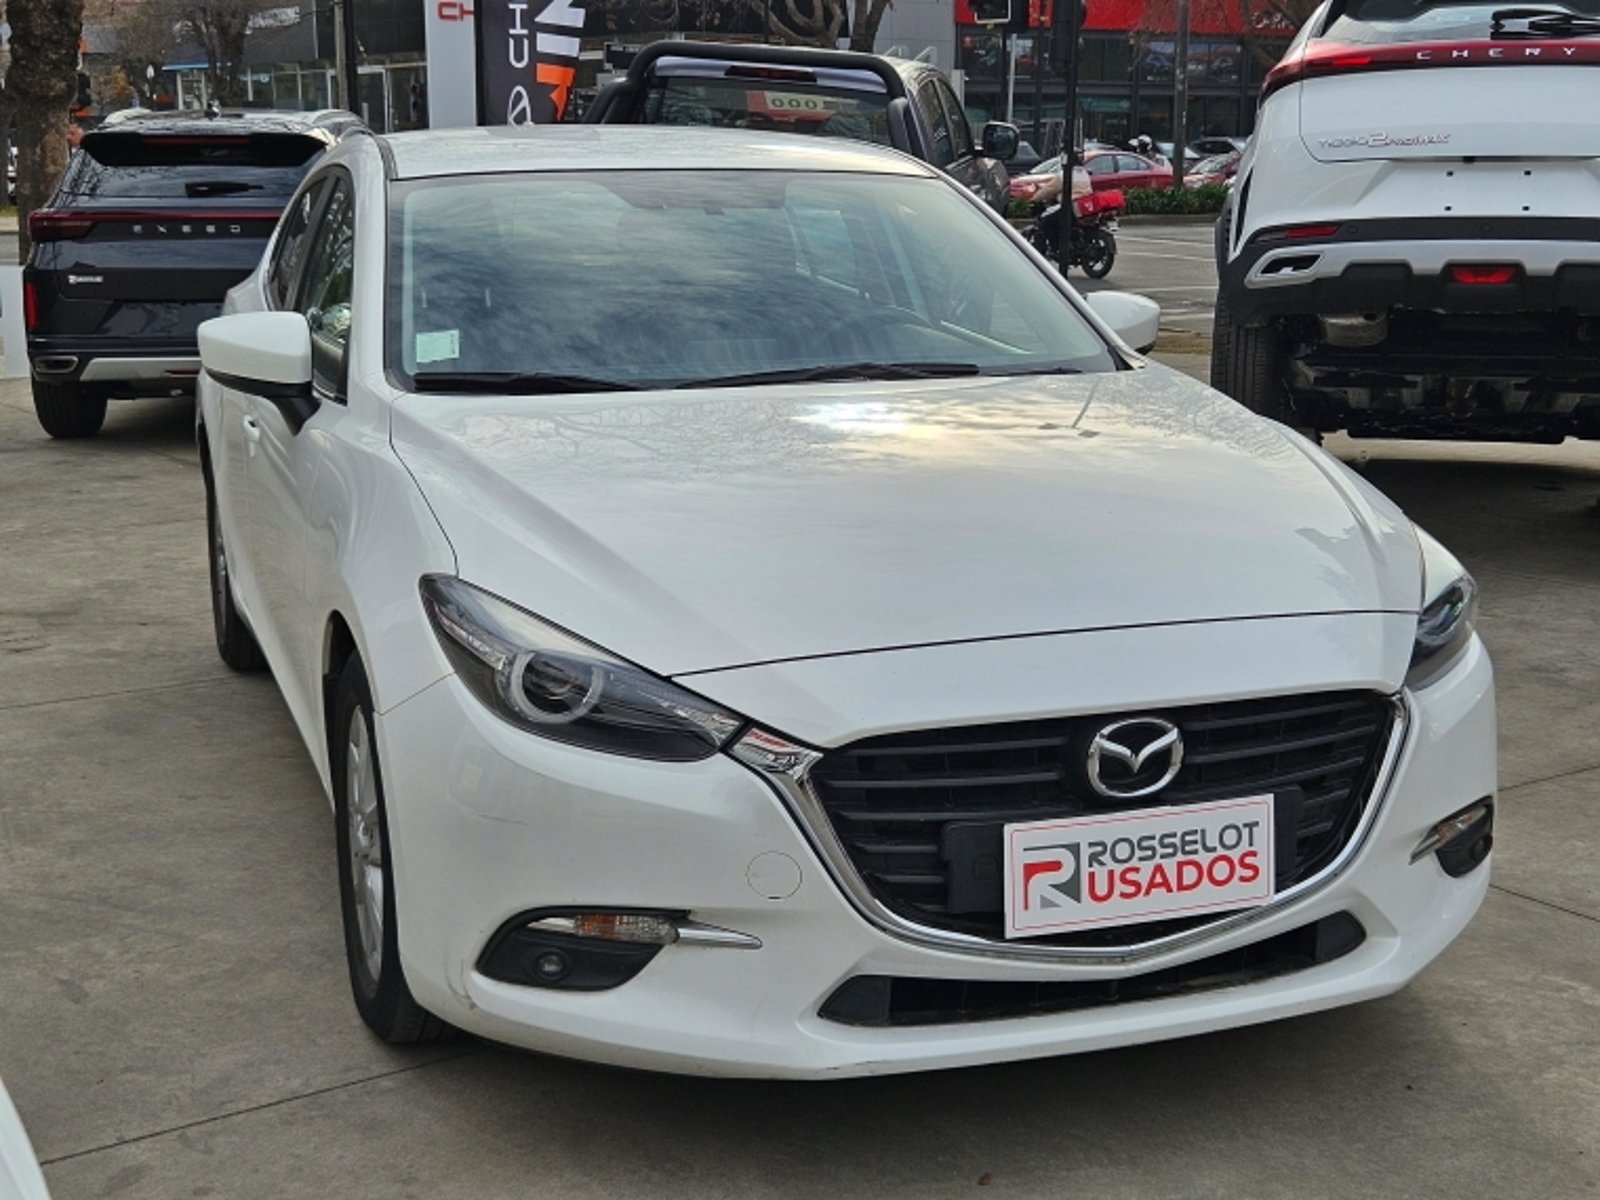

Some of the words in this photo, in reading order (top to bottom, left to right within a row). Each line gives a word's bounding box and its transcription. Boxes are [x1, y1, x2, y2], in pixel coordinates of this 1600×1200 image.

[1416, 47, 1576, 60] CHERY
[1087, 821, 1260, 868] ROSSELOT
[1087, 850, 1260, 903] USADOS
